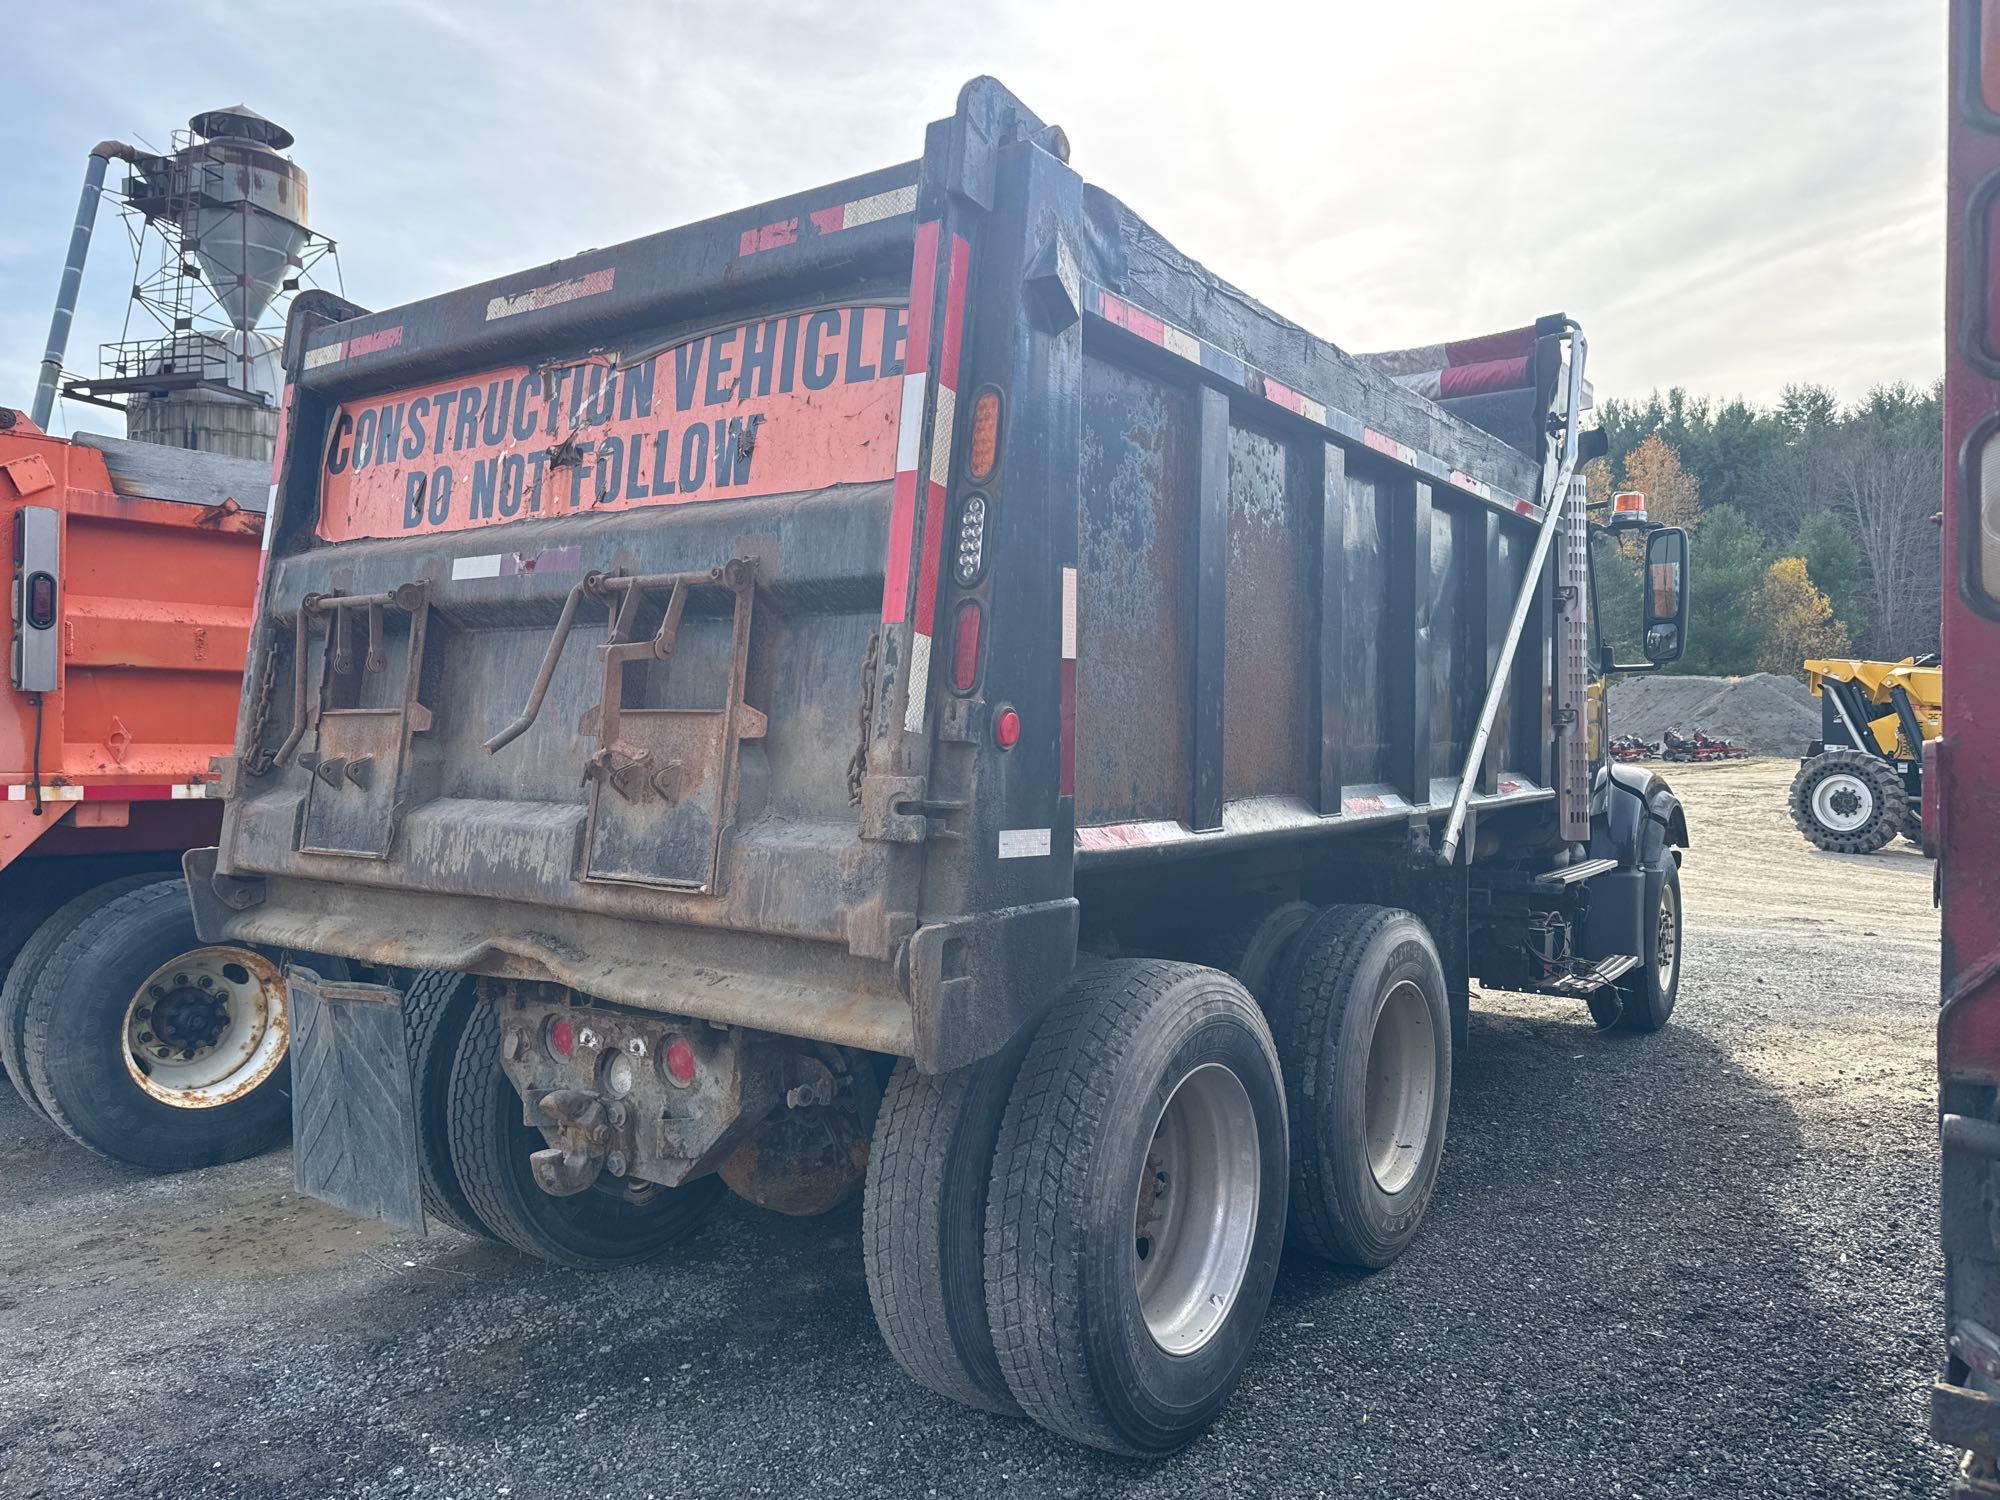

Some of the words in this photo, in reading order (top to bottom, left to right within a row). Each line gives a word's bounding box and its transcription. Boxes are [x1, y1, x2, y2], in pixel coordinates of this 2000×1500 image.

[328, 357, 657, 475] CONSTRUCTION
[674, 308, 910, 412] VEHICLE
[403, 465, 451, 529] DO
[469, 450, 553, 520] NOT
[569, 413, 765, 507] FOLLOW
